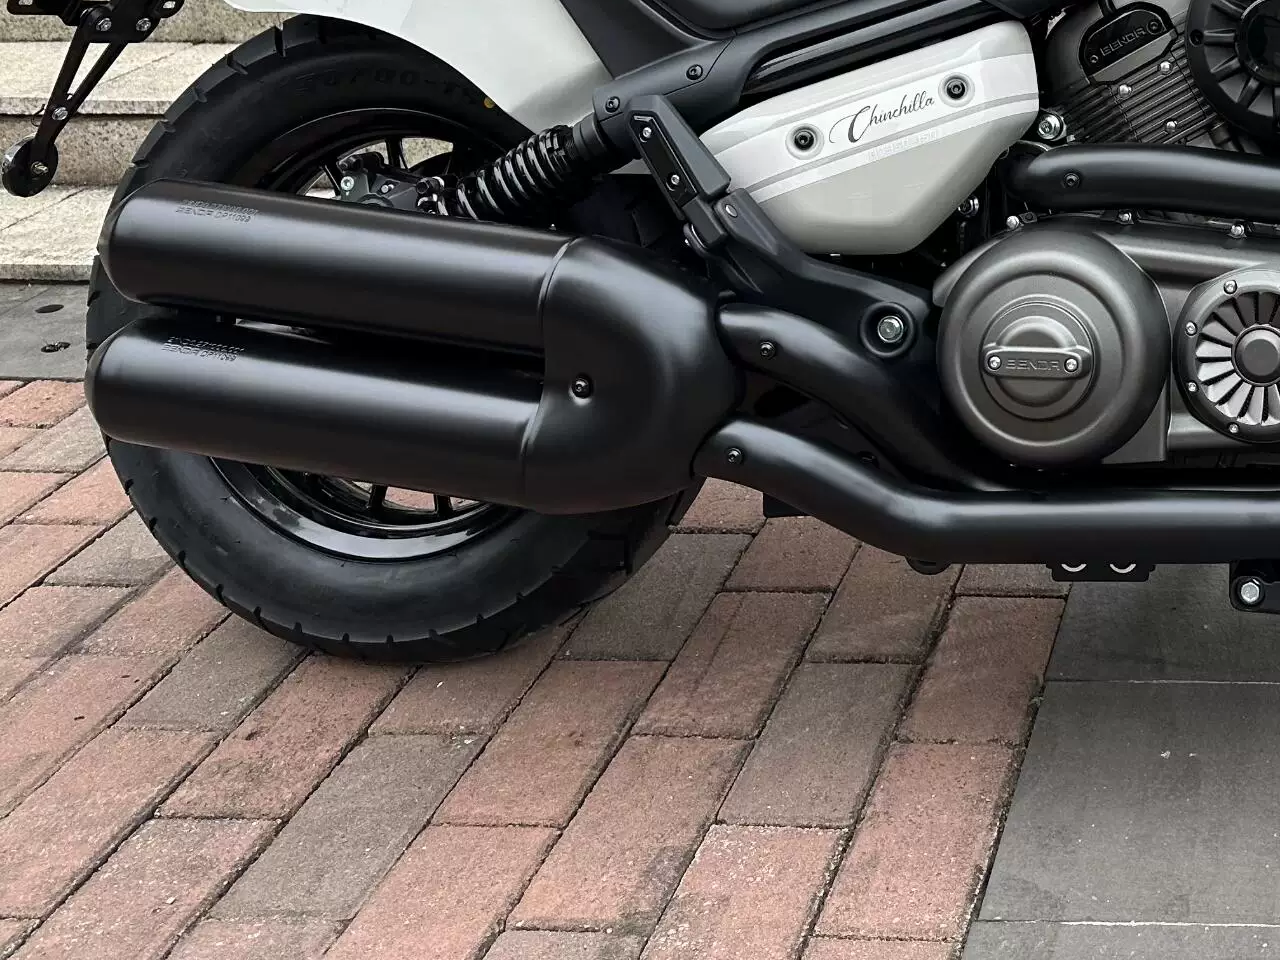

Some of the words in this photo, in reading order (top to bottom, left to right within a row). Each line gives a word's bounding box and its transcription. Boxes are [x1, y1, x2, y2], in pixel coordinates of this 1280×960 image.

[1099, 25, 1148, 57] BENDA
[829, 90, 935, 144] Chinchilla
[1005, 358, 1061, 371] BENDA
